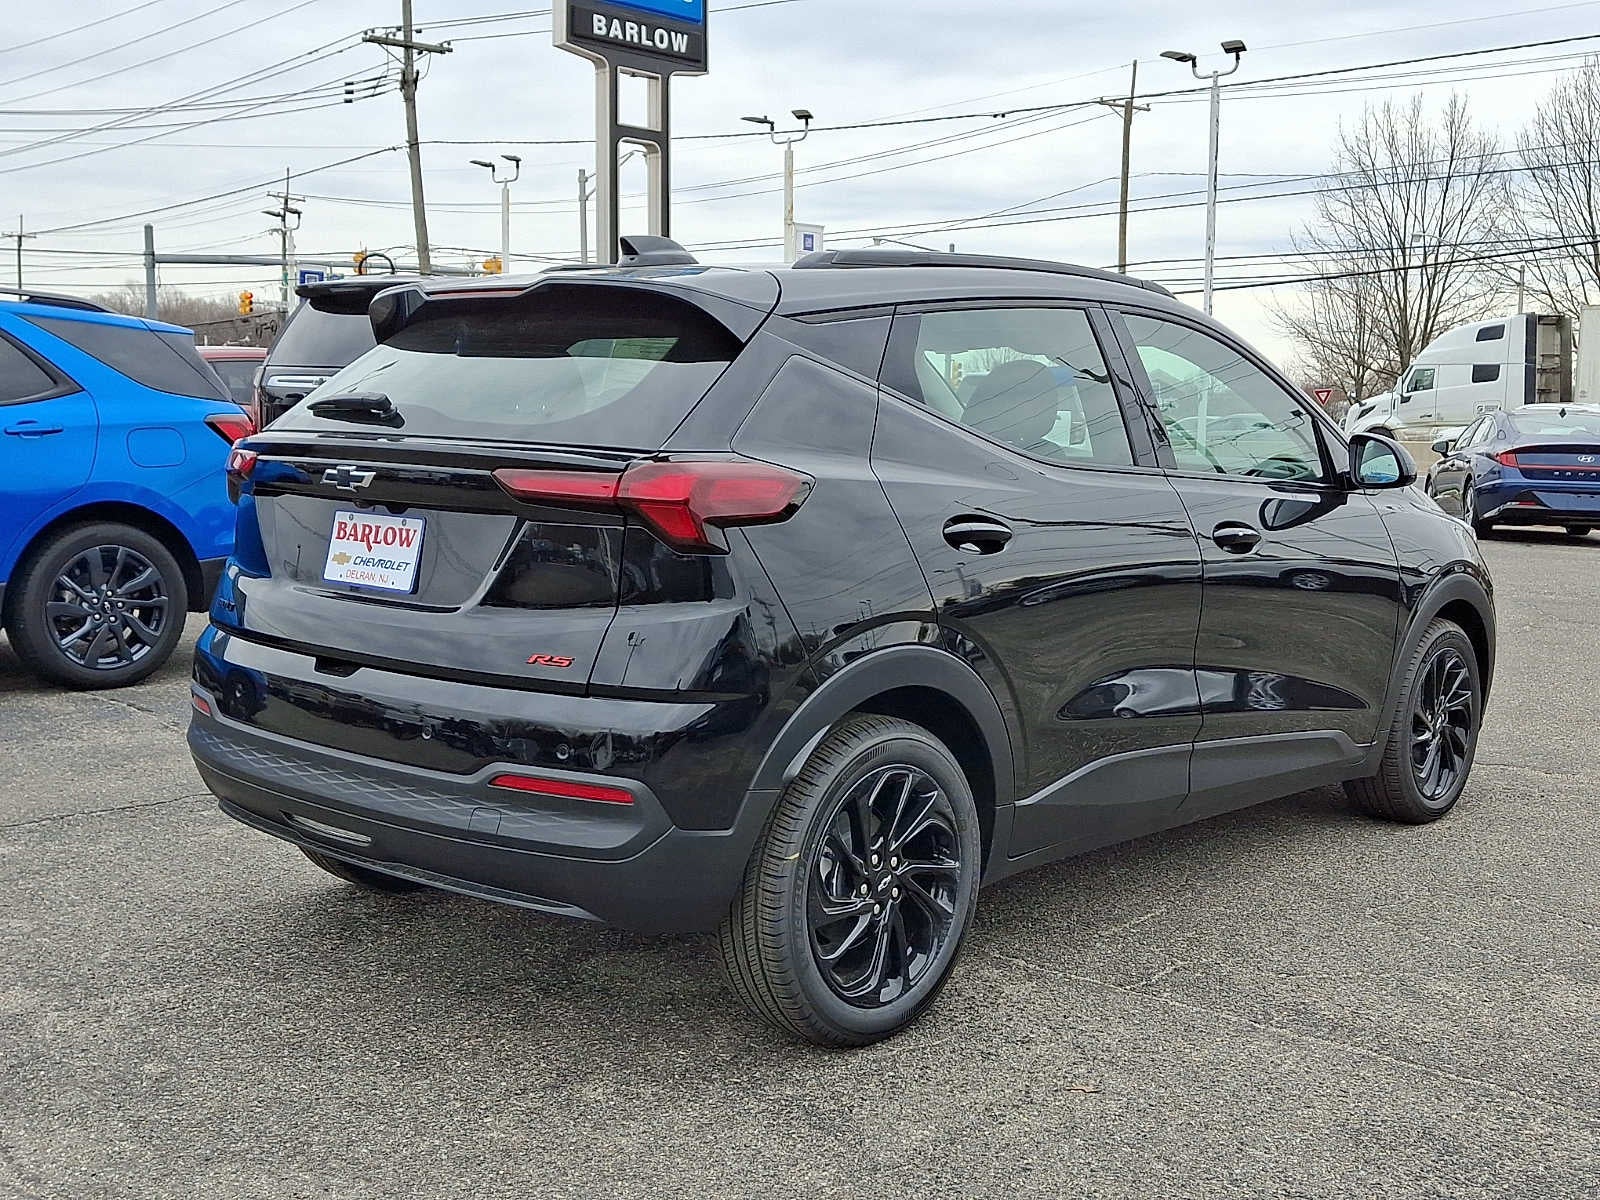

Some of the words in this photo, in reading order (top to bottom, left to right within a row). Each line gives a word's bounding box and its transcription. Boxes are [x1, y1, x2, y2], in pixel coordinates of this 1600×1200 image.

[592, 13, 689, 54] BARLOW
[335, 520, 418, 553] BARLOW
[353, 555, 411, 572] CHEVROLET
[378, 573, 389, 583] NJ
[526, 653, 575, 668] RS
